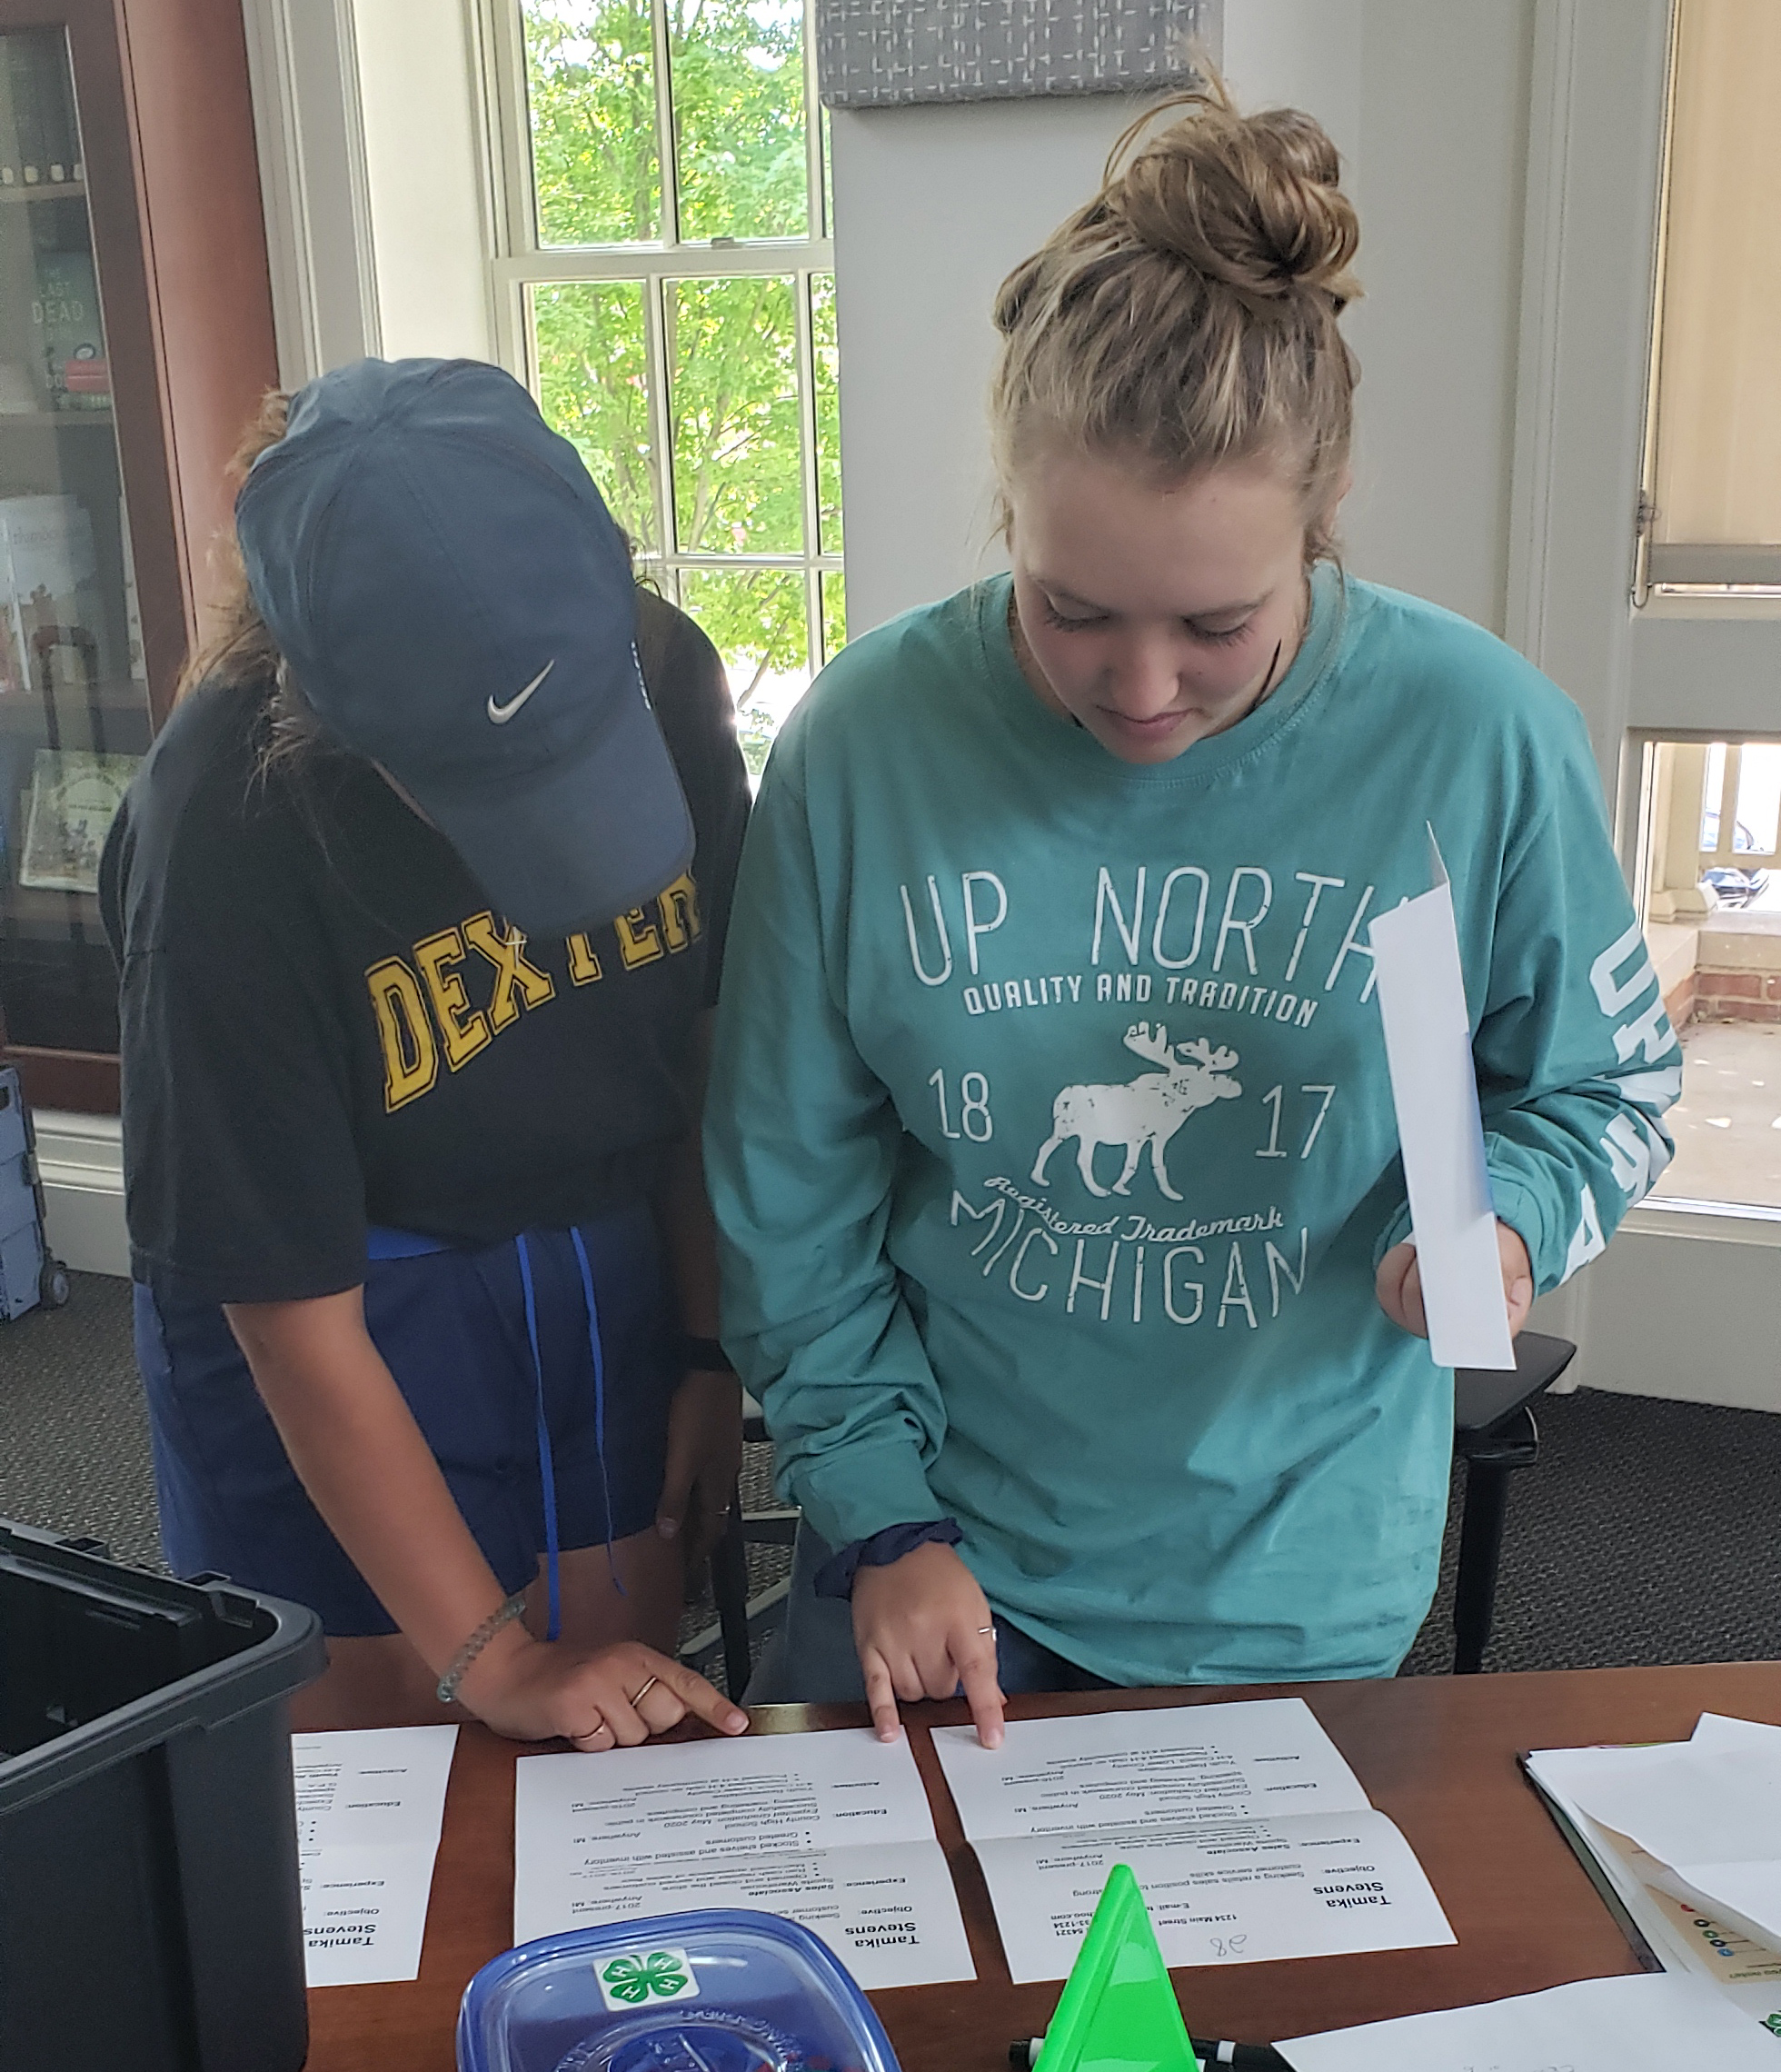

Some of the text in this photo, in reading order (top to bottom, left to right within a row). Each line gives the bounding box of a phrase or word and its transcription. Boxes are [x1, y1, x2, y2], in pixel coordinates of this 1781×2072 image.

[32, 300, 85, 324] DEAD
[900, 865, 1410, 1004] UP NORTH
[963, 973, 1318, 1029] QUALITY AND TRADITION
[928, 1068, 995, 1143] 18
[1255, 1084, 1337, 1160] 17
[983, 1176, 1284, 1243] Registered Trademark
[950, 1189, 1308, 1329] MICHIGAN
[1143, 1807, 1194, 1816] customers
[725, 1814, 820, 1830] County High School
[1030, 1824, 1074, 1834] inventory
[1077, 1823, 1096, 1832] with
[705, 1831, 798, 1845] Greeted customers
[720, 1843, 757, 1853] shelves
[760, 1839, 800, 1850] Stocked
[654, 1850, 696, 1859] assisted
[698, 1847, 717, 1856] and
[1207, 1847, 1258, 1856] Associate
[583, 1856, 630, 1867] inventory
[632, 1854, 652, 1863] with
[1189, 1869, 1214, 1878] skills
[1217, 1867, 1252, 1876] service
[1263, 1870, 1304, 1880] Seeking
[1150, 1880, 1189, 1890] position
[1312, 1881, 1384, 1896] Stevens
[749, 1883, 834, 1898] Sales Associate
[1326, 1894, 1390, 1909] Tamika
[323, 1908, 380, 1917] Objective:
[792, 1905, 839, 1914] customer
[798, 1912, 840, 1922] Seeking
[1050, 1911, 1095, 1921] hoo.com
[1189, 1916, 1213, 1924] Main
[1158, 1918, 1187, 1927] Street
[303, 1925, 376, 1936] Stevens
[845, 1922, 916, 1936] Stevens
[1055, 1928, 1083, 1937] 54321
[309, 1937, 374, 1948] Tamika
[854, 1936, 920, 1948] Tamika
[1209, 1935, 1247, 1957] 28
